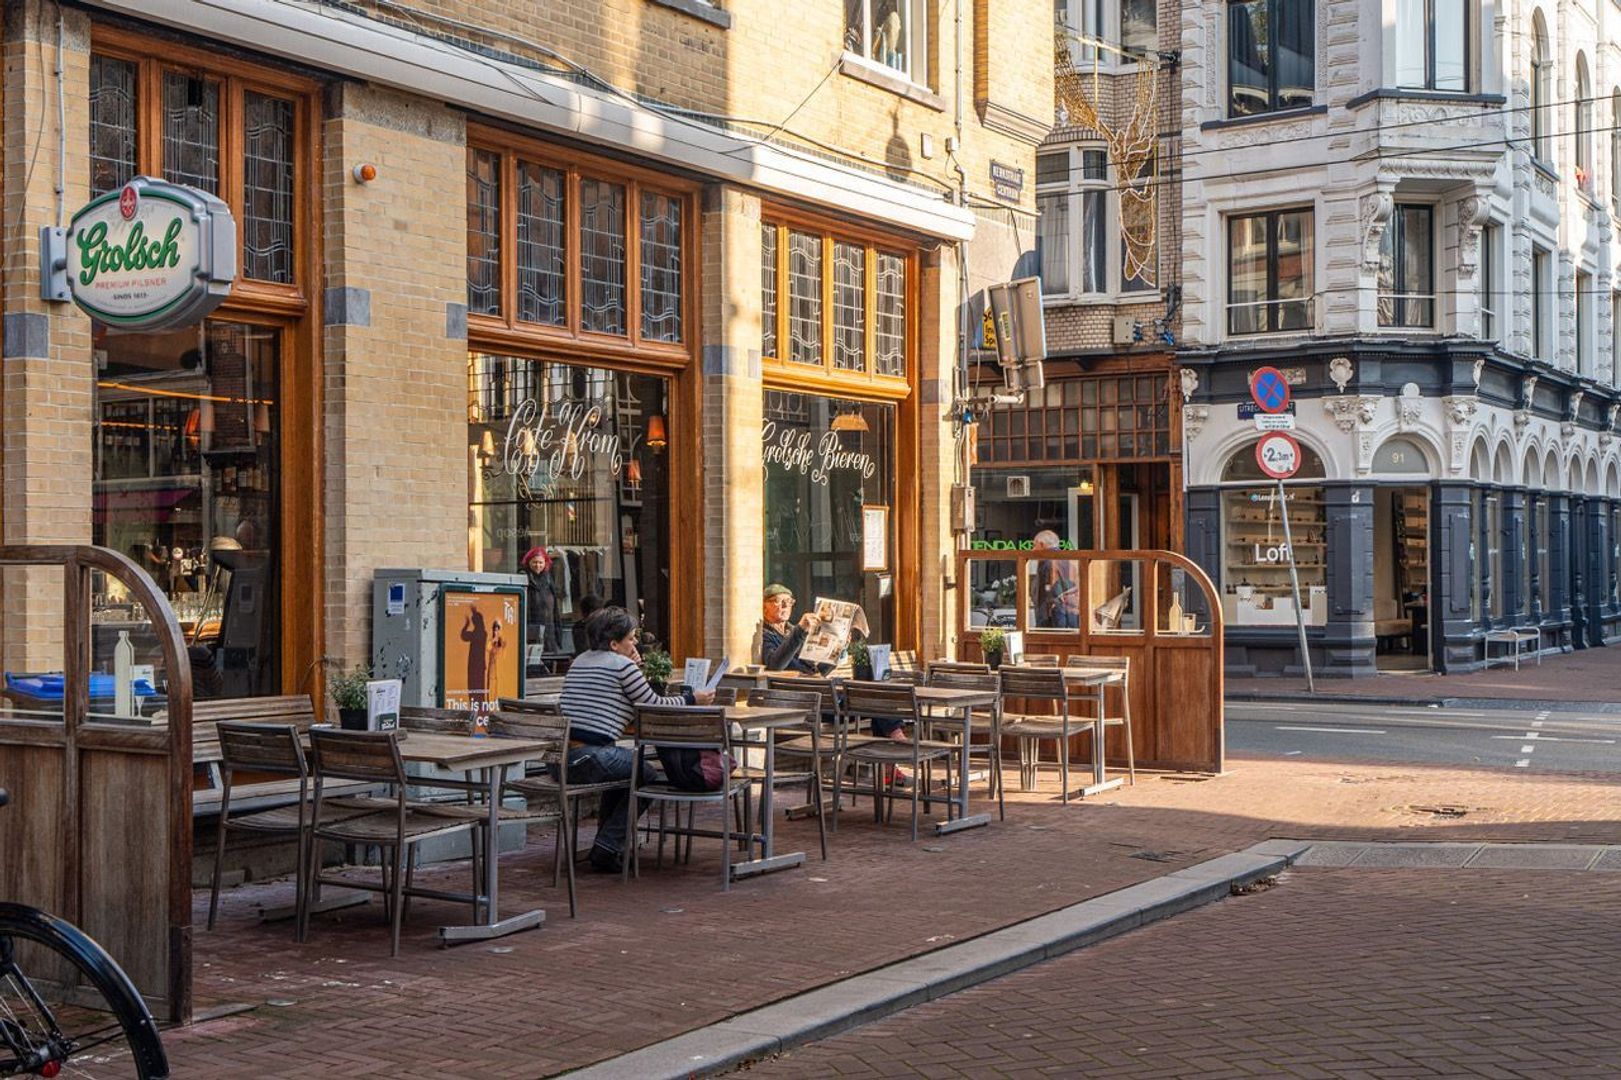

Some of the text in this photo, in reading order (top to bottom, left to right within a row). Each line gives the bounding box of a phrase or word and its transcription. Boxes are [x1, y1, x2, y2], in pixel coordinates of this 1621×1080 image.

[77, 217, 183, 286] Grolsch
[95, 277, 167, 290] PREMIUM PILSNER
[549, 402, 622, 480] Krom
[811, 427, 875, 486] Bieren
[1391, 451, 1404, 464] 91
[446, 697, 500, 711] This is not
